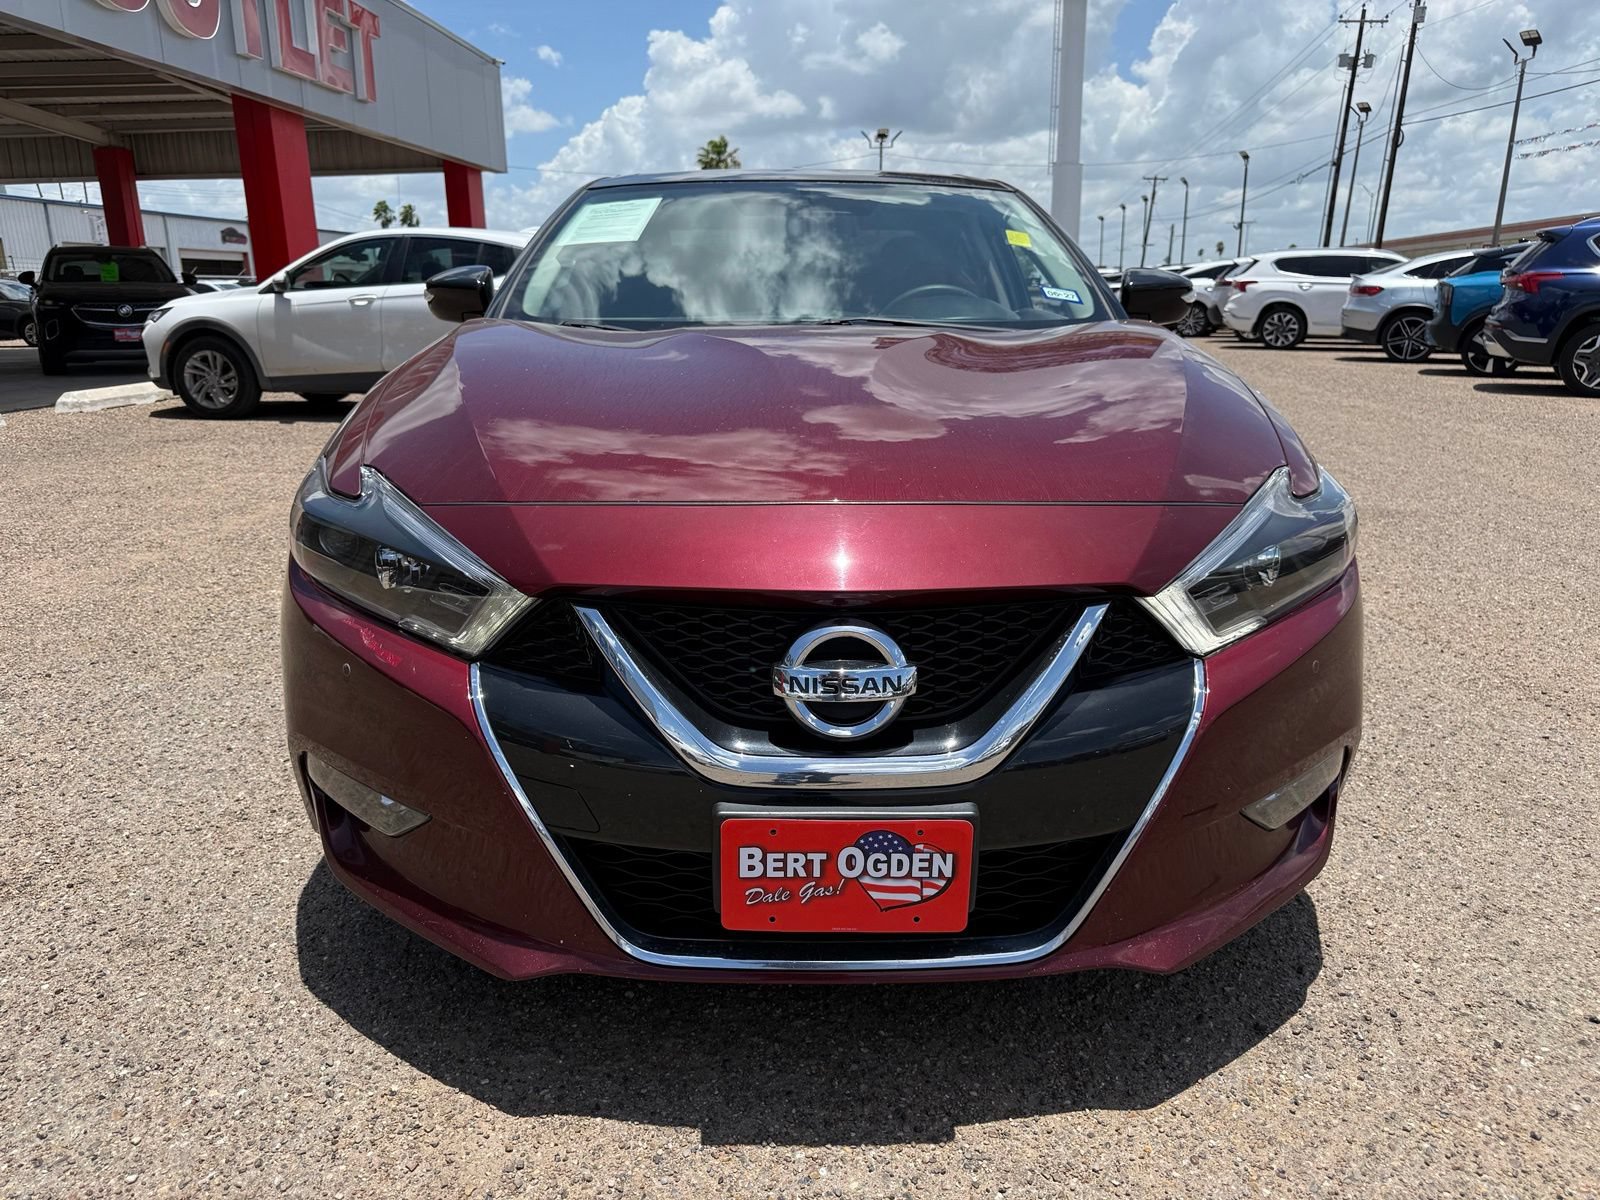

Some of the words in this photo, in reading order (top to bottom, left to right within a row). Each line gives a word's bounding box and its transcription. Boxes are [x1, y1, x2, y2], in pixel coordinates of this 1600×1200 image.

[789, 675, 902, 694] NISSAN
[739, 847, 827, 878] BERT
[837, 846, 953, 878] OGDEN
[745, 887, 790, 905] Dale
[799, 879, 845, 904] Gas!
